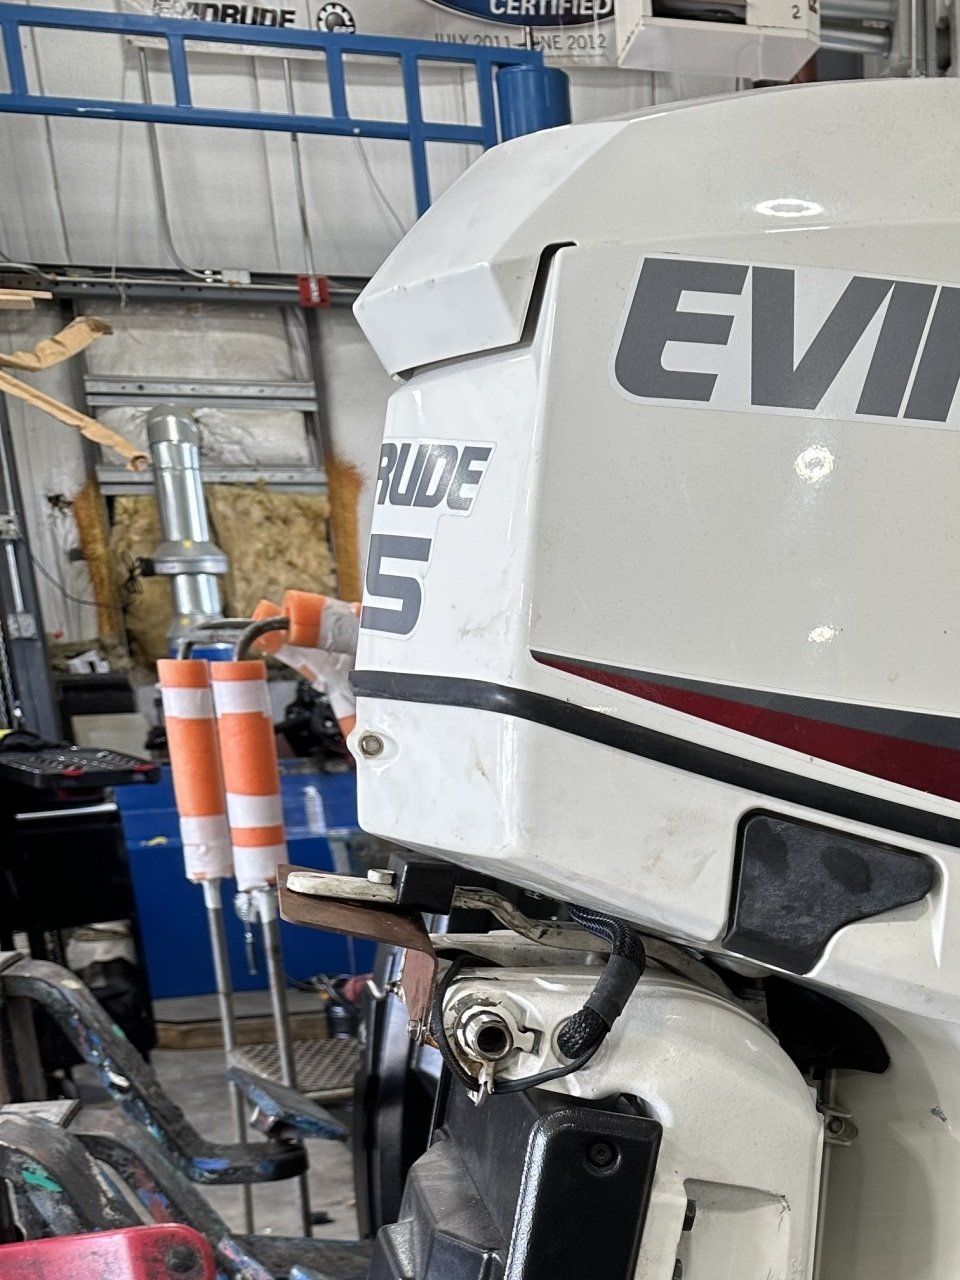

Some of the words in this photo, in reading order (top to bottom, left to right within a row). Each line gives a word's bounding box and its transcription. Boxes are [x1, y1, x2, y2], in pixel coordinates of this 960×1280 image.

[489, 0, 612, 15] CERTIFIED
[791, 4, 802, 20] 2
[567, 34, 607, 50] 2012
